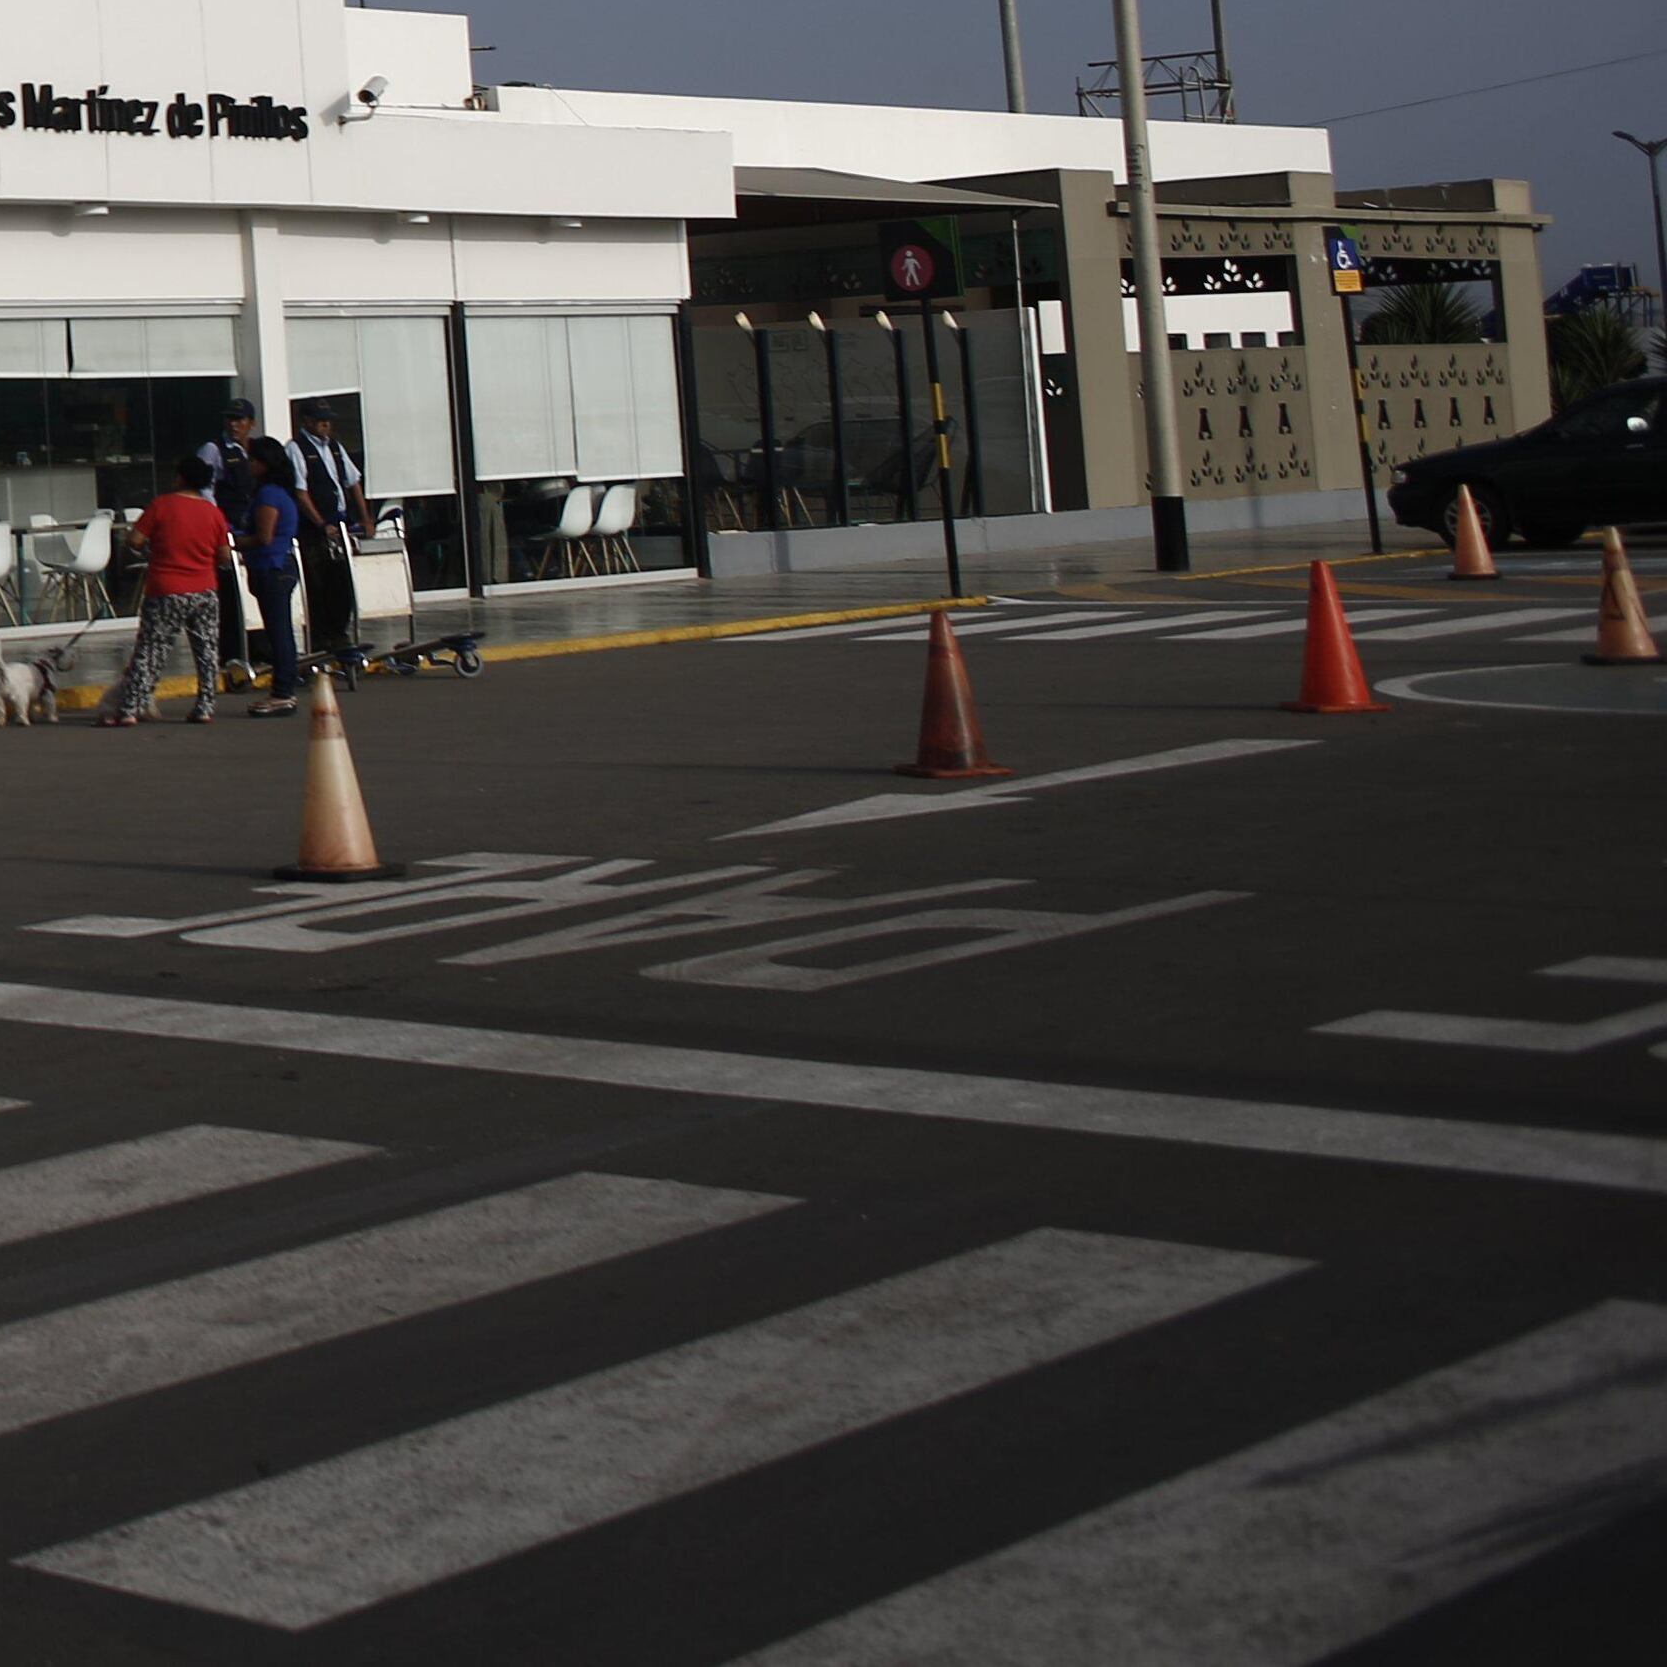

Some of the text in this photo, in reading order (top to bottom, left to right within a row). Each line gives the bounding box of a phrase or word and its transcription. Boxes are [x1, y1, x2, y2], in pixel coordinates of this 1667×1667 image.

[20, 83, 161, 137] Martínez
[166, 92, 204, 139] de
[207, 93, 309, 142] Pinillos
